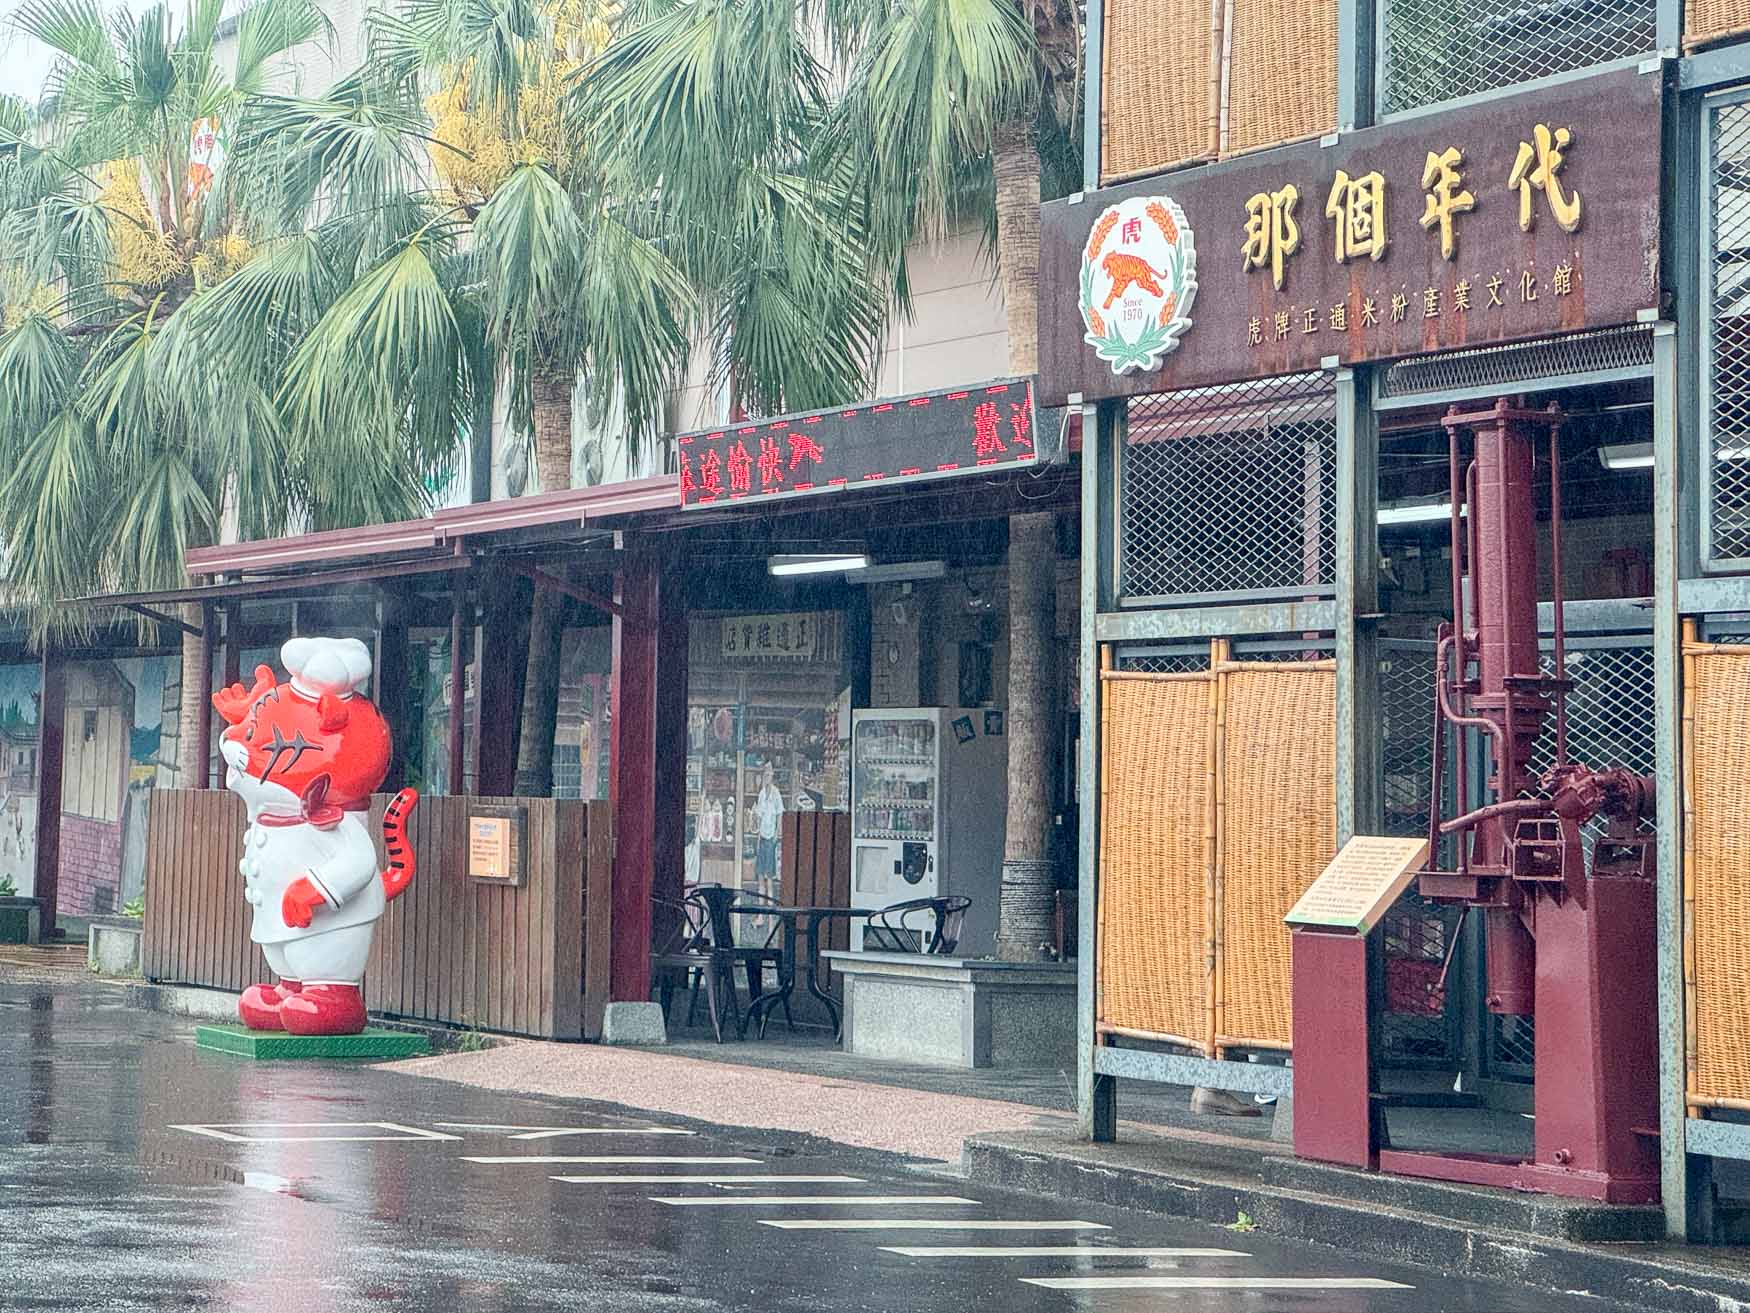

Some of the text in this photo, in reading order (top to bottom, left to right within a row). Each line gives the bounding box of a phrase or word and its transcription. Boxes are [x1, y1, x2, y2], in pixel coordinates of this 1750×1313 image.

[1242, 123, 1580, 291] 那個年代
[1122, 216, 1142, 245] 虎
[1123, 297, 1143, 308] Since
[1123, 309, 1143, 322] 1970
[1247, 263, 1574, 347] 虎牌正通米粉產業文化館
